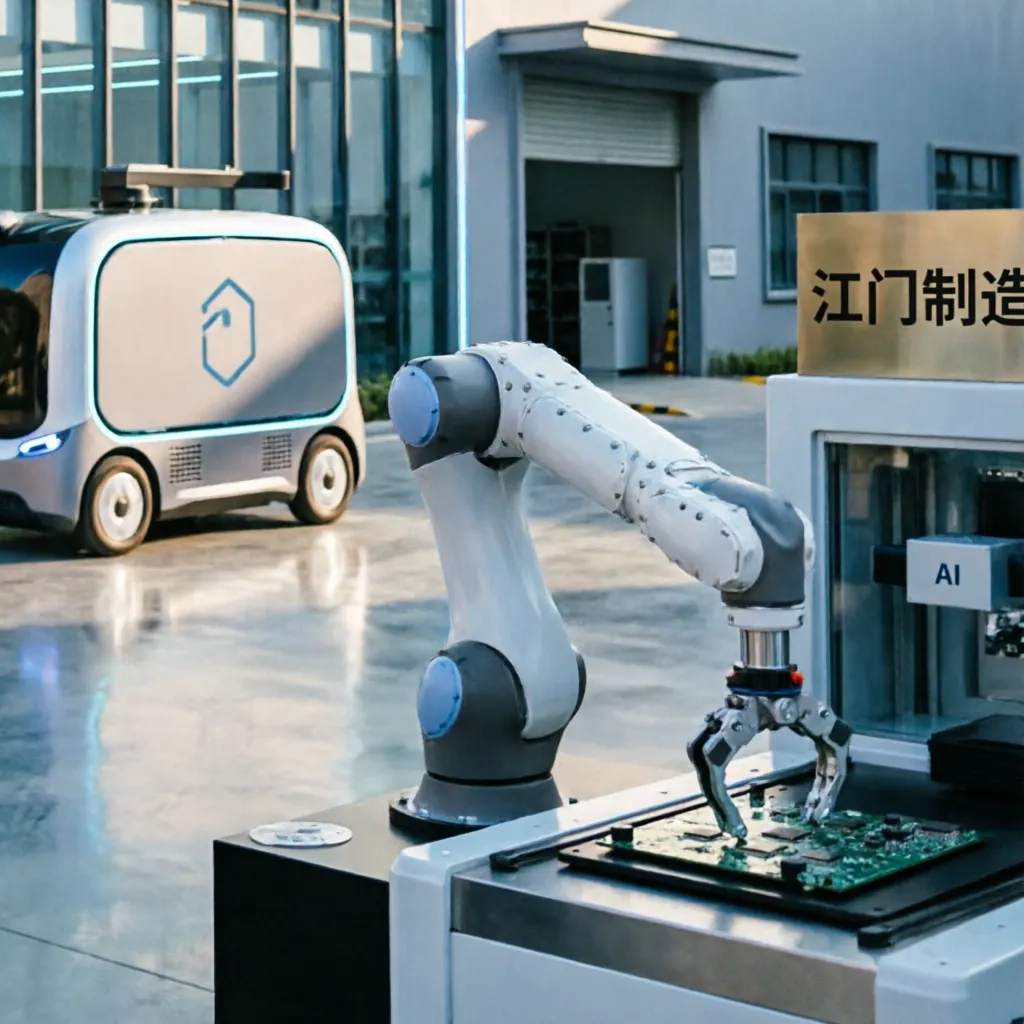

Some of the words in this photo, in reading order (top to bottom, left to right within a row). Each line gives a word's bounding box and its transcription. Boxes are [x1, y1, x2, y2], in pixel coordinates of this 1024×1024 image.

[812, 268, 1024, 326] 江门制造
[935, 563, 960, 585] AI
